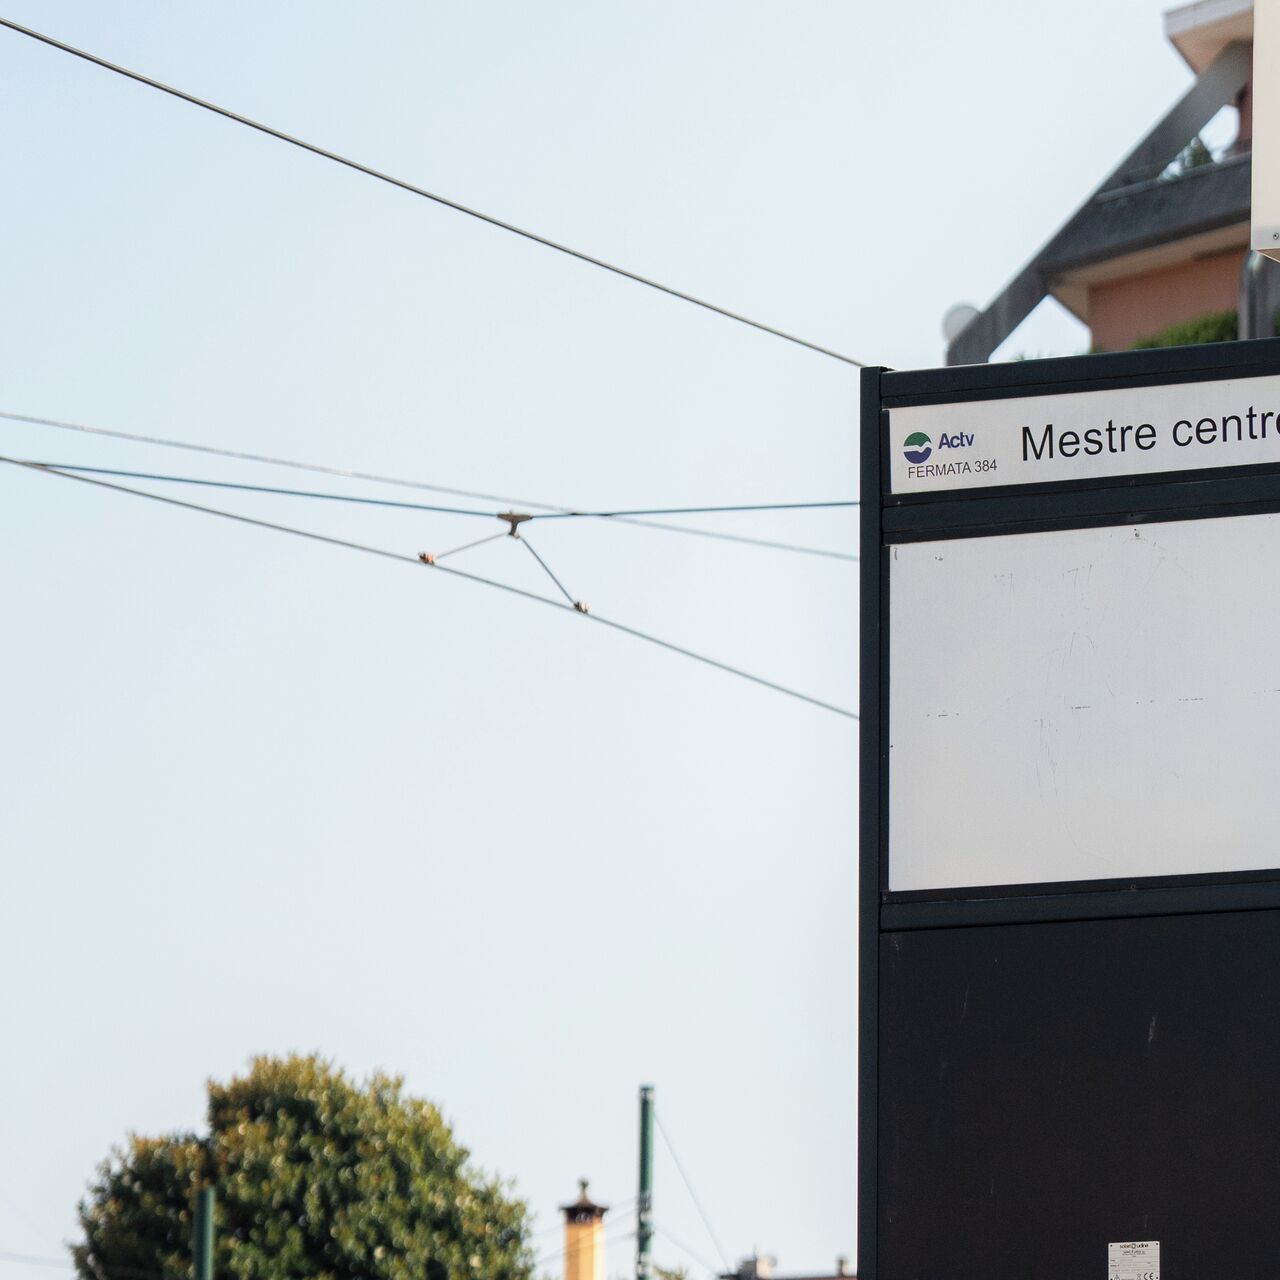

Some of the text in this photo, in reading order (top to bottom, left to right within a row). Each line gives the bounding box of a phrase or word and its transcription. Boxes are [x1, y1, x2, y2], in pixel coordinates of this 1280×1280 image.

[938, 432, 974, 449] Actv
[1022, 419, 1157, 462] Mestre
[908, 459, 997, 479] FERMATA 384
